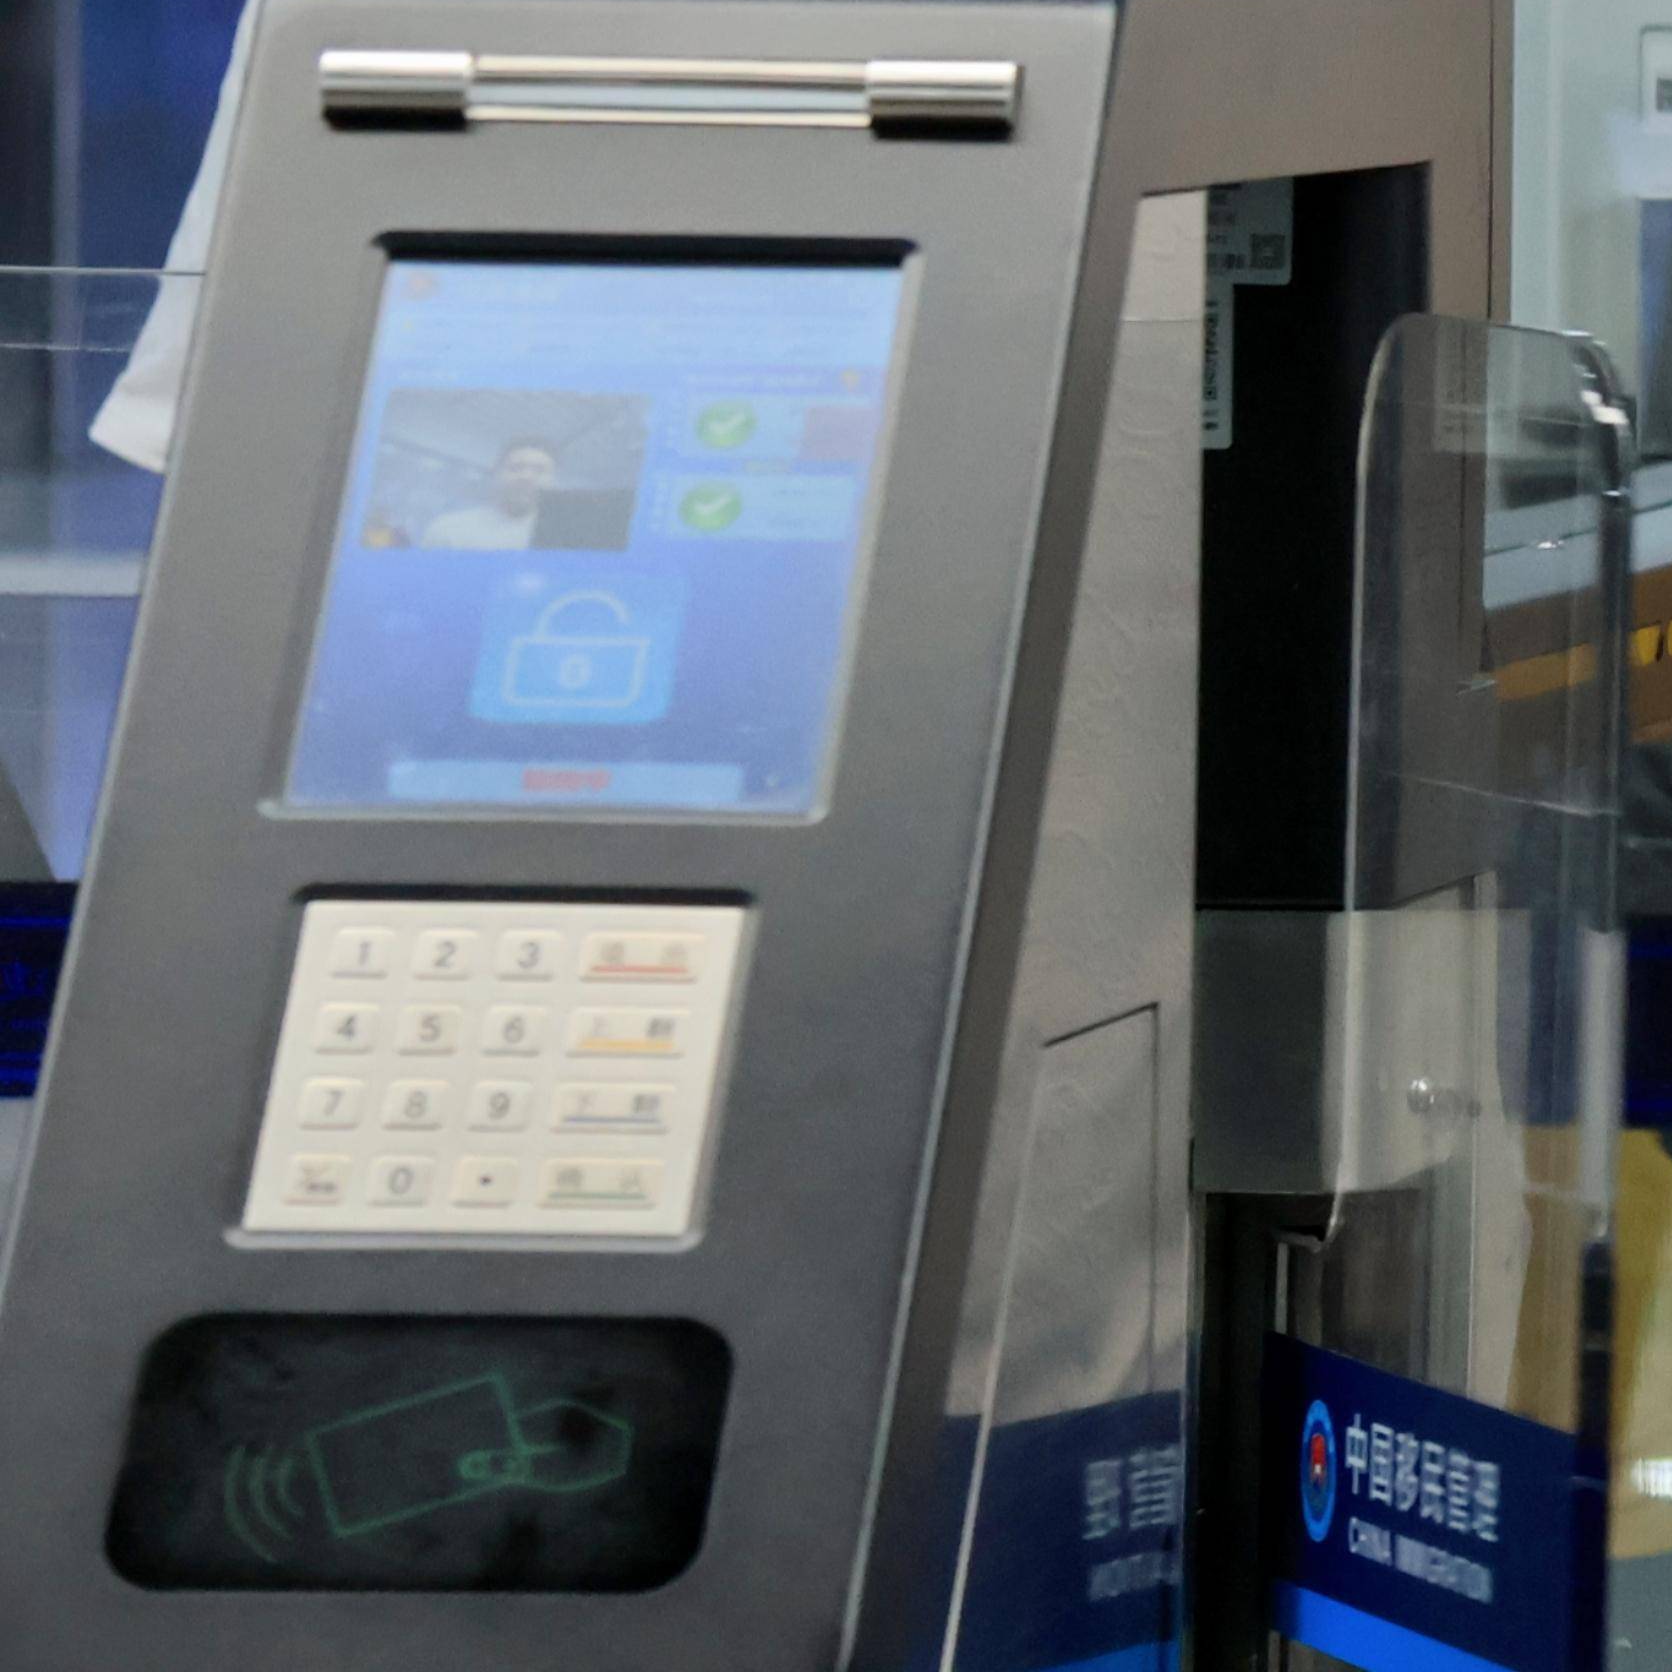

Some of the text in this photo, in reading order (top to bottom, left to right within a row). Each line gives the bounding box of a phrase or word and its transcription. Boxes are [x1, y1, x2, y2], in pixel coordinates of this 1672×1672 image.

[358, 940, 540, 969] 1 2 3
[336, 1015, 526, 1044] 4 5 6
[322, 1089, 512, 1120] 7 8 9
[387, 1166, 413, 1195] 0
[1344, 1413, 1500, 1542] 中国移民管理
[1348, 1516, 1393, 1567] CHINA
